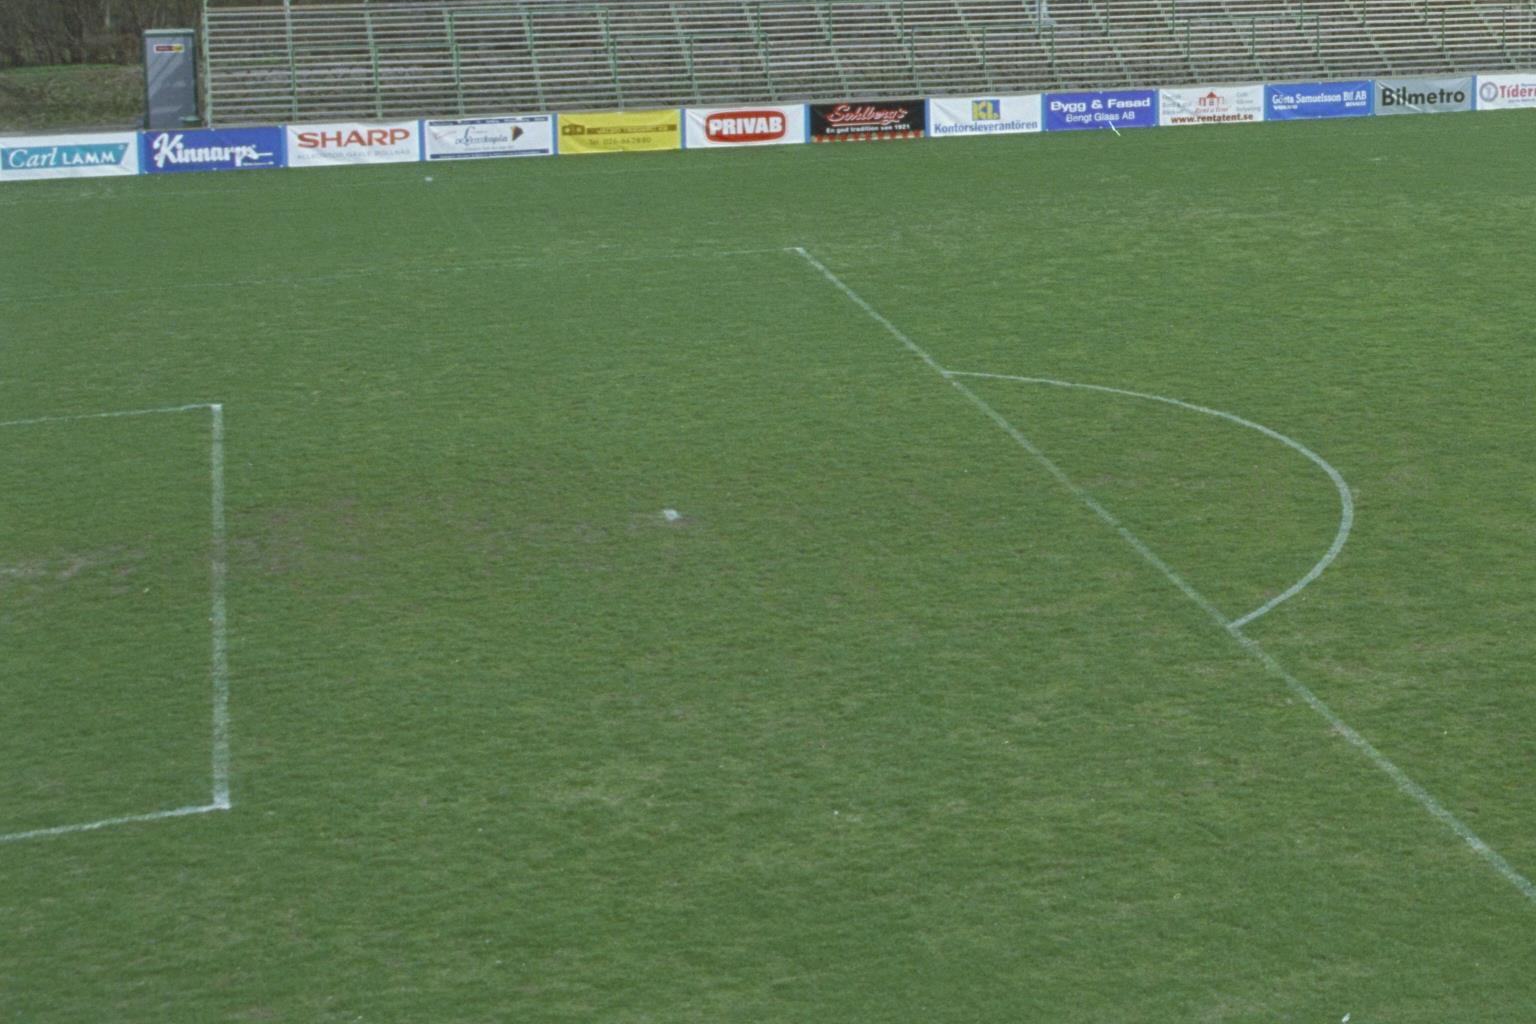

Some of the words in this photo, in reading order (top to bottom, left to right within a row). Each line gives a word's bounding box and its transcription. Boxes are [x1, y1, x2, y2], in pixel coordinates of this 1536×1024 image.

[1050, 101, 1087, 113] Bygg
[1091, 99, 1103, 109] &
[1107, 97, 1151, 109] Fasad
[1295, 92, 1342, 104] Samuelsson
[1355, 90, 1367, 101] AB
[1381, 87, 1465, 107] Bilmetro
[709, 117, 783, 135] PRIVAB
[1066, 113, 1092, 124] Bengt
[1122, 111, 1135, 120] AB
[1171, 113, 1254, 124] www.rentatent.se
[934, 119, 1038, 134] Kontorsleverantören
[297, 128, 410, 148] SHARP
[8, 146, 57, 168] Carl
[62, 151, 116, 165] LAMM
[153, 132, 270, 168] Kinnarps
